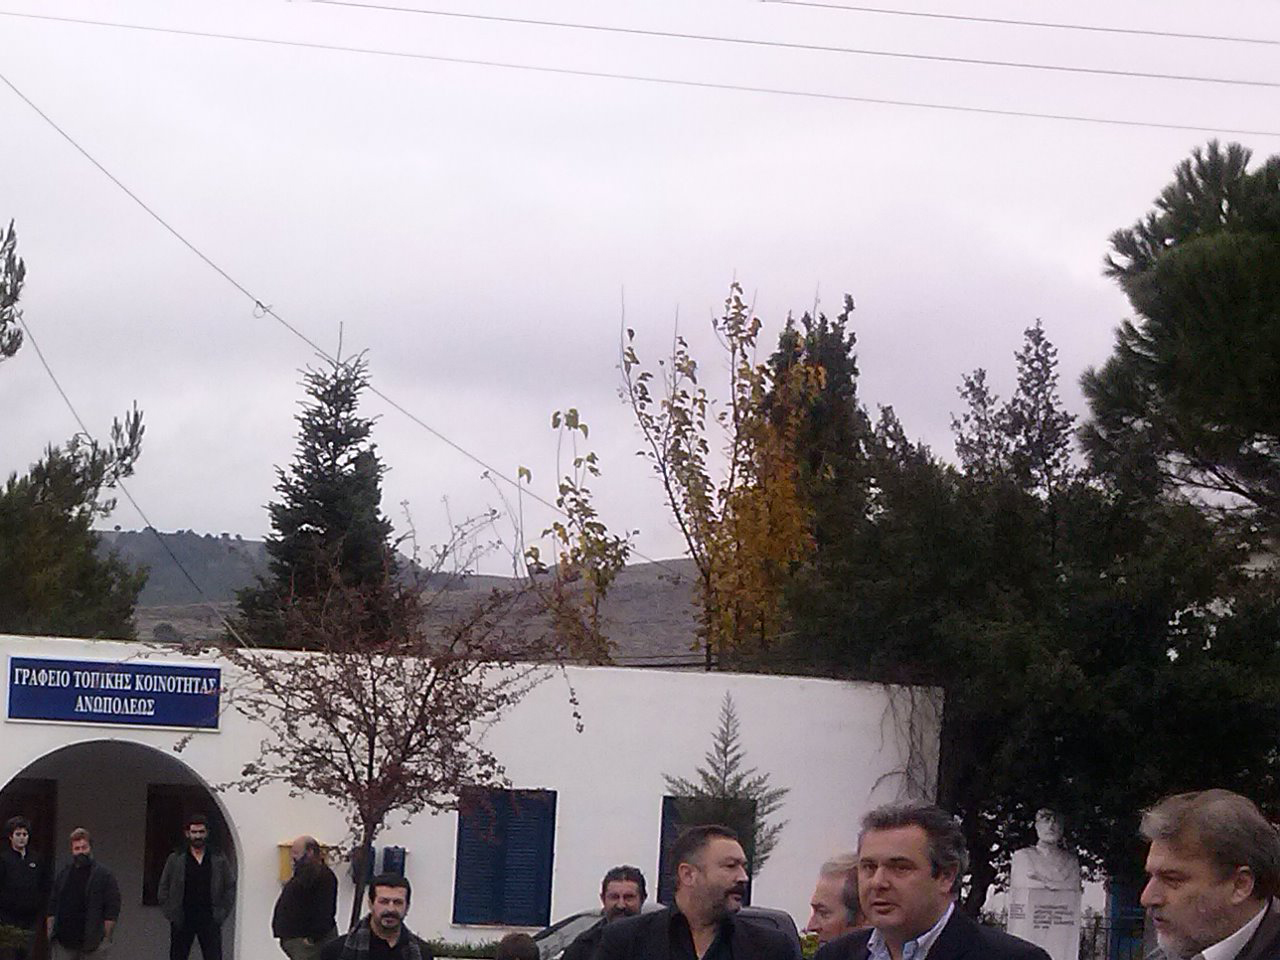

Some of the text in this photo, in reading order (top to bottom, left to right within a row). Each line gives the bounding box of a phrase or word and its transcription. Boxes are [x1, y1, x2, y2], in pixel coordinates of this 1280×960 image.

[14, 668, 217, 694] ΓΡΑΦΕΙΟ ΤΟΠΙΚΗΣ ΚΟΙΝΟΤΗΤΑΣ
[74, 696, 155, 715] ΑΝΩΠΟΛΕΩΣ
